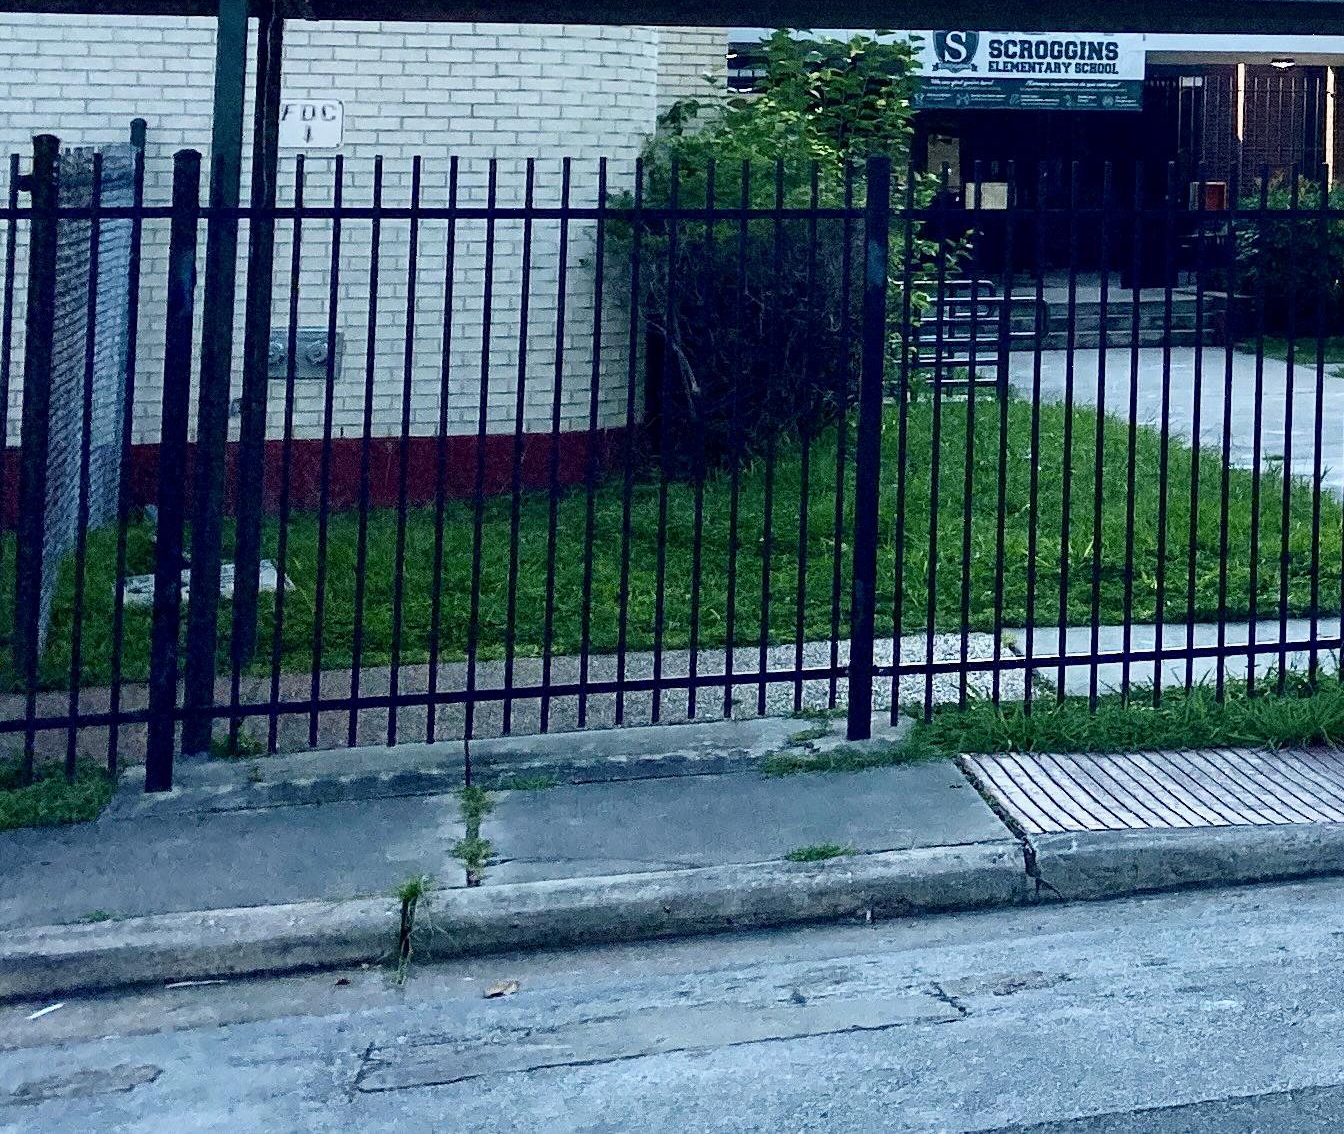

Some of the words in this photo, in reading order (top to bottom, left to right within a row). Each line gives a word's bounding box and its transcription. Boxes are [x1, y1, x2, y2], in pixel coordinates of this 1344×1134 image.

[943, 30, 967, 63] S
[988, 39, 1119, 61] SCROGGINS
[988, 60, 1071, 74] ELEMENTARY
[1074, 62, 1119, 75] SCHOOL
[281, 103, 338, 123] FDC
